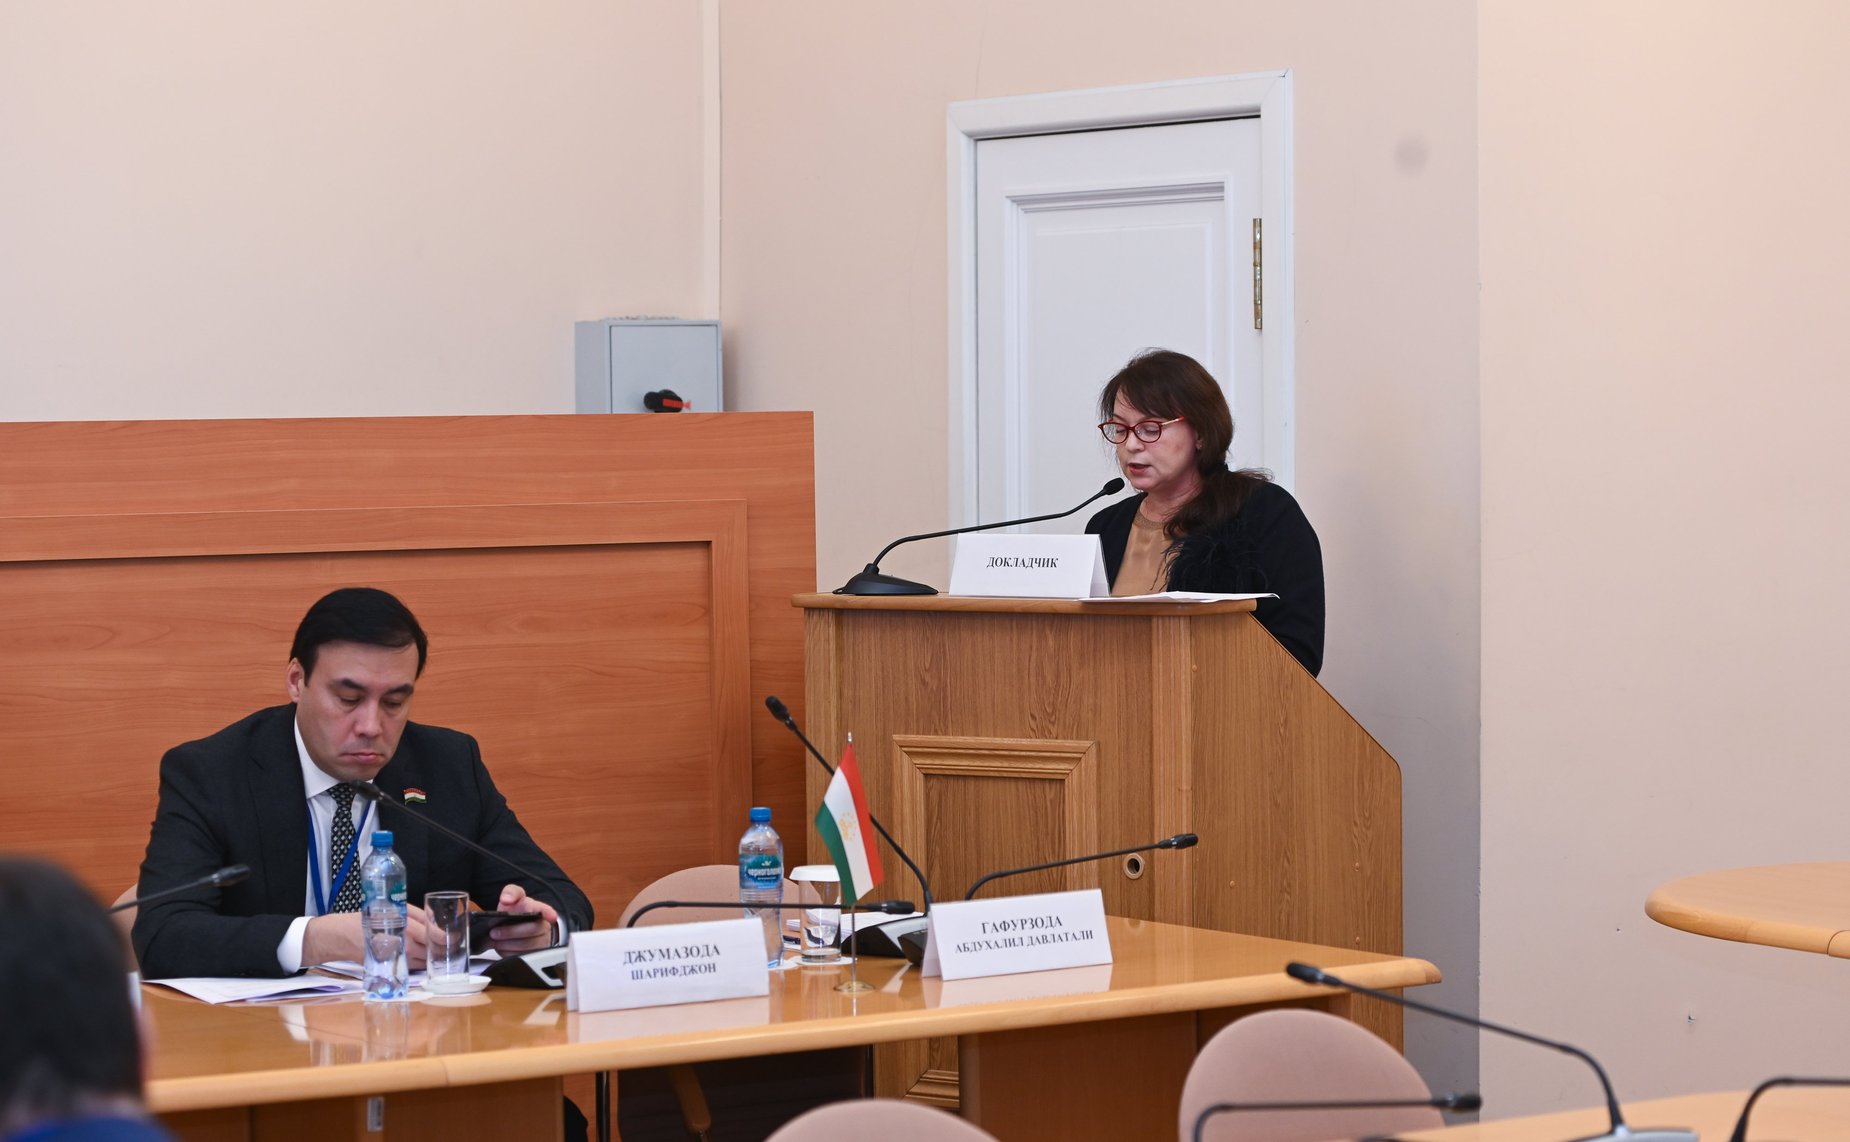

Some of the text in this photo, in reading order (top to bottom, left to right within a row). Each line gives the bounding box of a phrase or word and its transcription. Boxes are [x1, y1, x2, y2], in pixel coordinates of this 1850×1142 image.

[986, 556, 1059, 569] ДОКЛАДЧИК
[981, 916, 1062, 934] ГАФУРЗОДА
[955, 930, 1093, 953] АБДУХАЛИЛ ДАВЛАТАЛИ
[623, 944, 720, 964] ДЖУМАЗОДА
[631, 963, 716, 980] ШАРИФДЖОН
